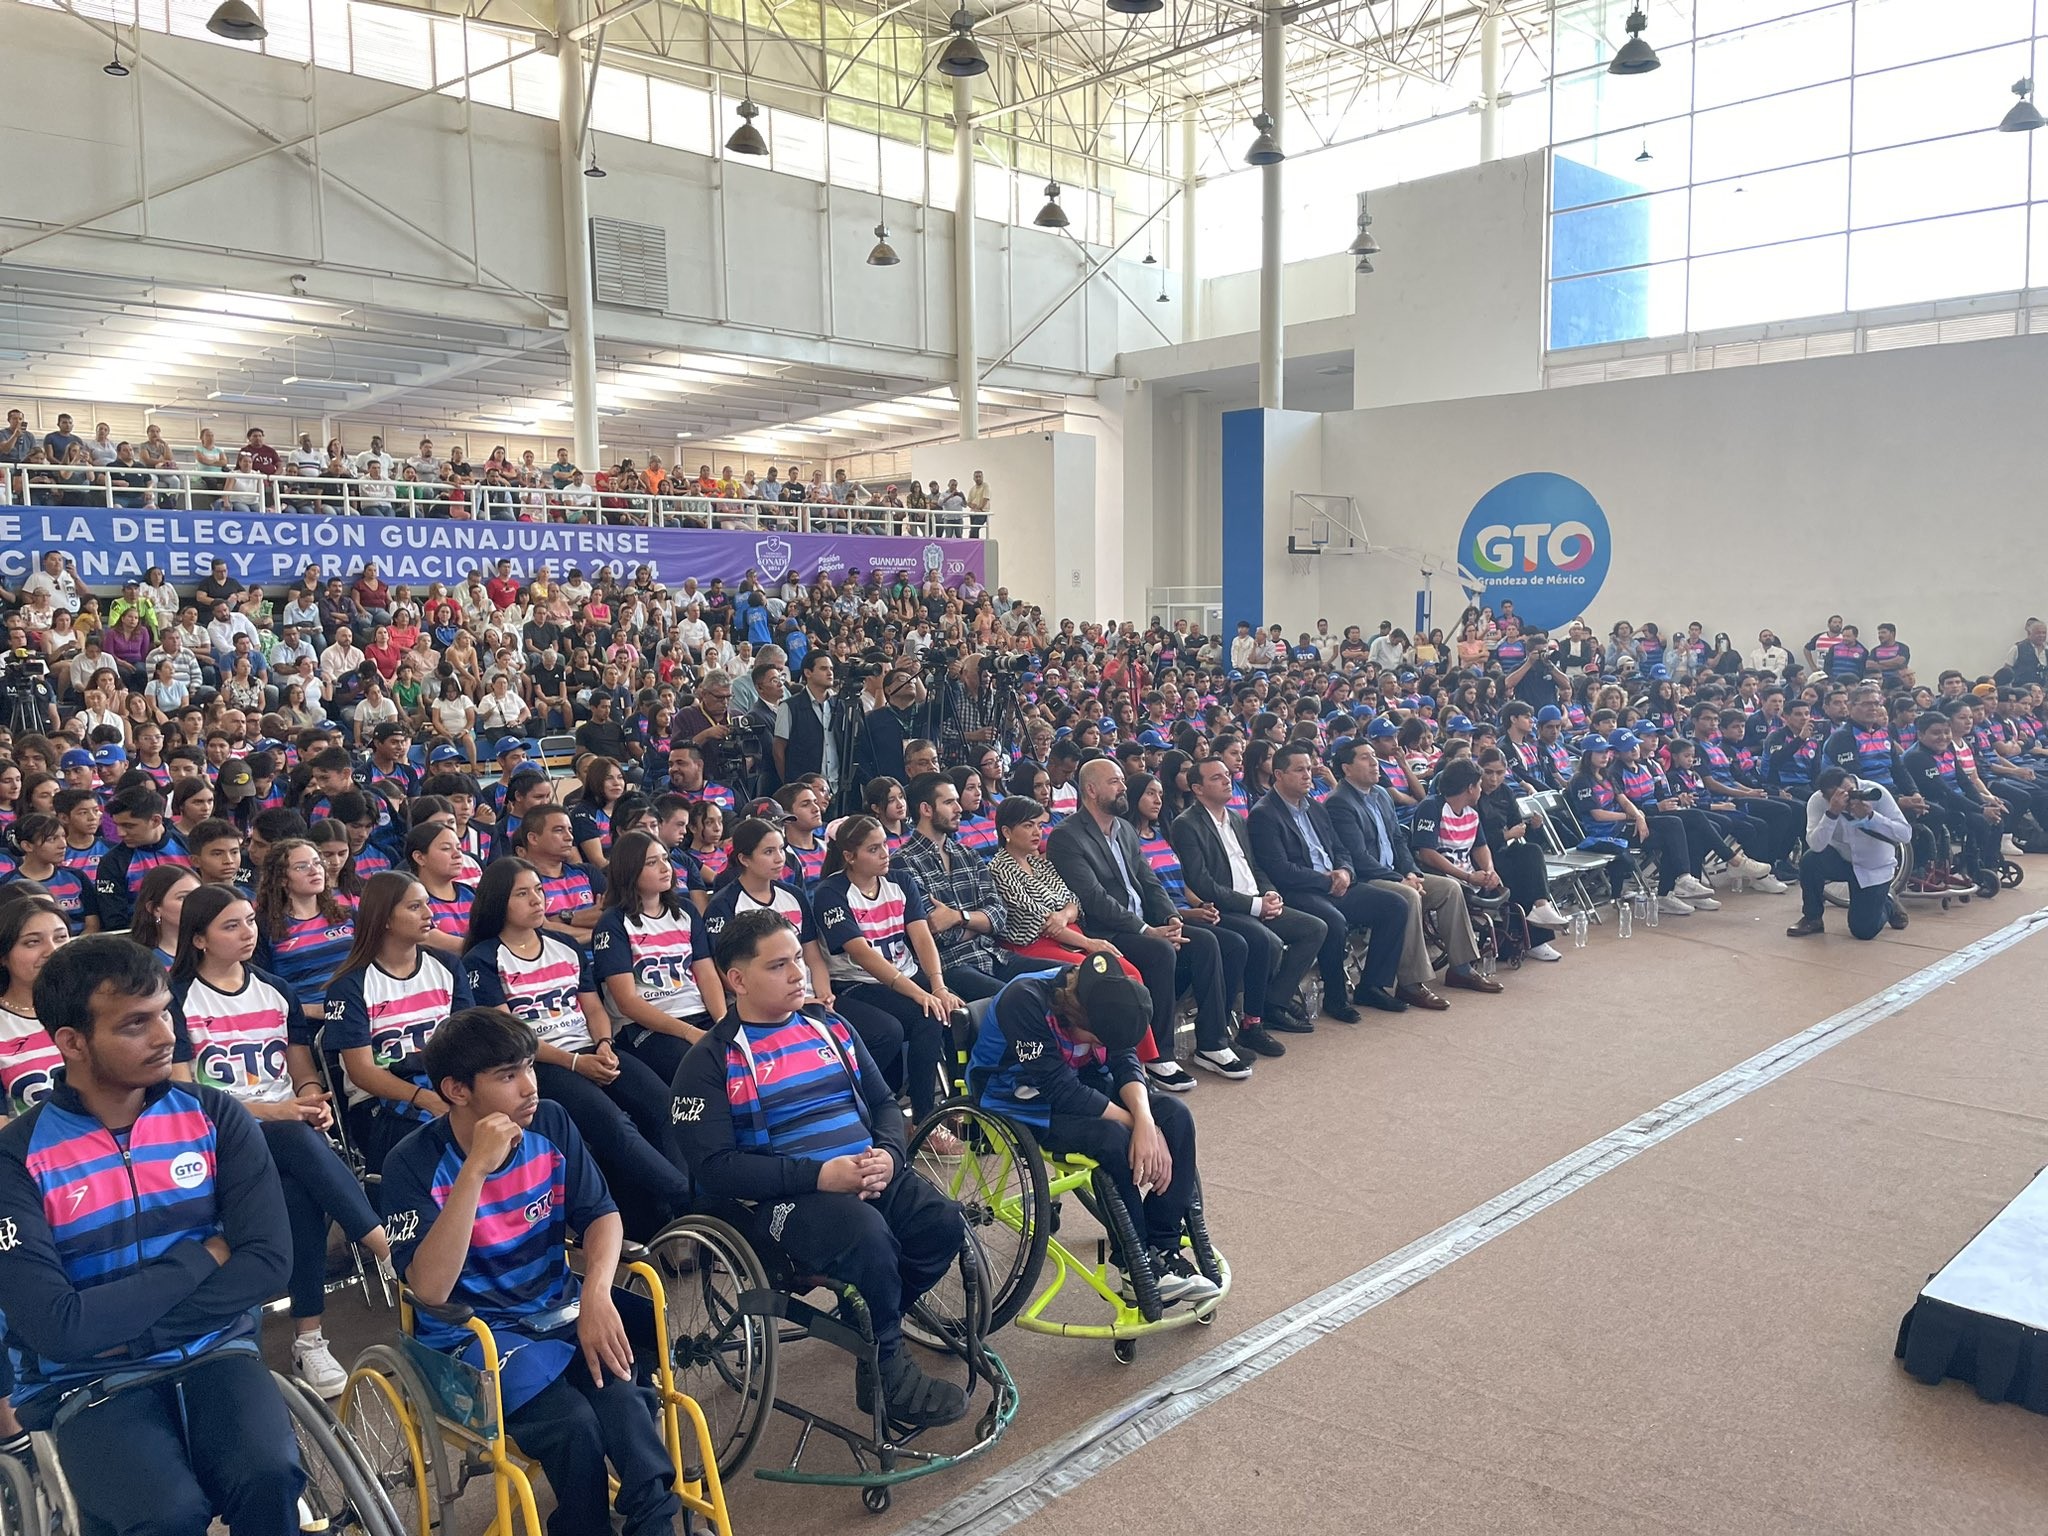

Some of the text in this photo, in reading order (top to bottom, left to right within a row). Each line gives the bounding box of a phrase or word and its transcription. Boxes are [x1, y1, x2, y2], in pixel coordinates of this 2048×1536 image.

[41, 515, 96, 542] LA
[112, 517, 366, 548] DELEGACIÓN
[380, 525, 650, 554] GUANAJUATENSE
[1473, 521, 1596, 573] GTO
[231, 552, 255, 576] Y
[272, 553, 578, 579] PARANACIONALES
[590, 559, 660, 580] 2024
[869, 557, 917, 566] GUANAJUATO
[1478, 574, 1586, 586] Grandeza de México
[64, 580, 77, 607] AERO
[197, 1039, 287, 1087] GTO
[675, 1096, 705, 1105] PLANET
[672, 1103, 705, 1124] Youth
[175, 1161, 204, 1176] GTO
